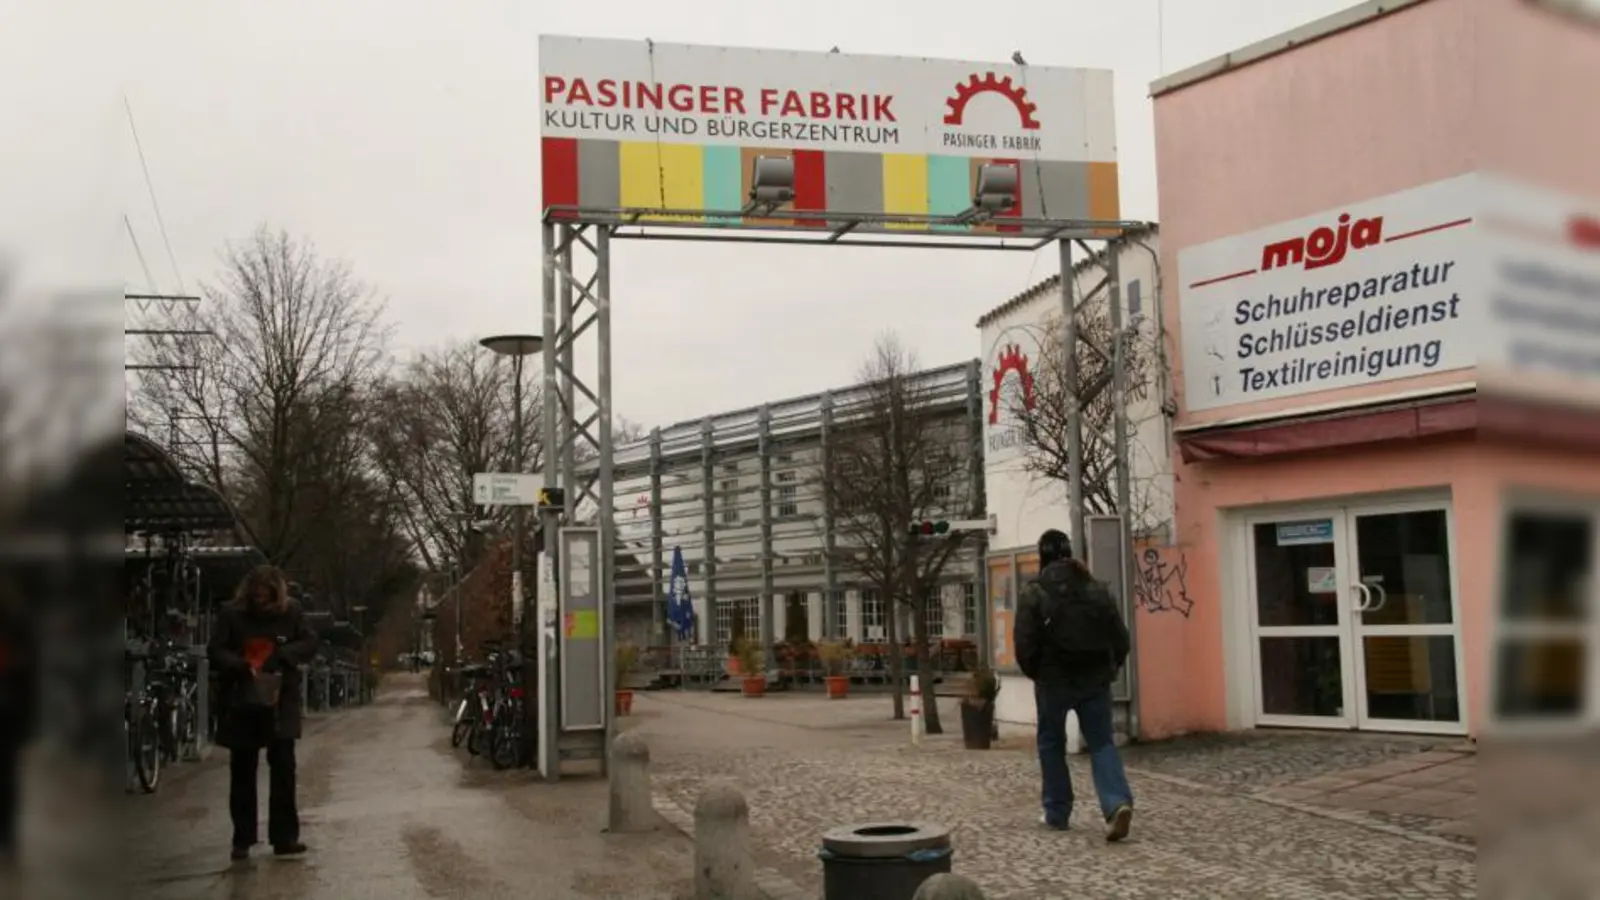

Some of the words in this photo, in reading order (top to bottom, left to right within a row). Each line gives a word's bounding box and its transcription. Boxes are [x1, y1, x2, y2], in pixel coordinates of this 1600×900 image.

[545, 76, 746, 114] PASINGER
[760, 89, 897, 122] FABRIK
[545, 109, 636, 132] KULTUR
[645, 116, 697, 134] UND
[707, 116, 900, 144] BÜRGERZENTRUM
[943, 132, 998, 149] PASINGER
[1002, 135, 1041, 151] FABRIK
[1261, 213, 1383, 271] moja
[1235, 258, 1455, 325] Schuhreparatur
[1237, 293, 1461, 359] Schlüsseldienst
[1240, 339, 1442, 393] Textilreinigung
